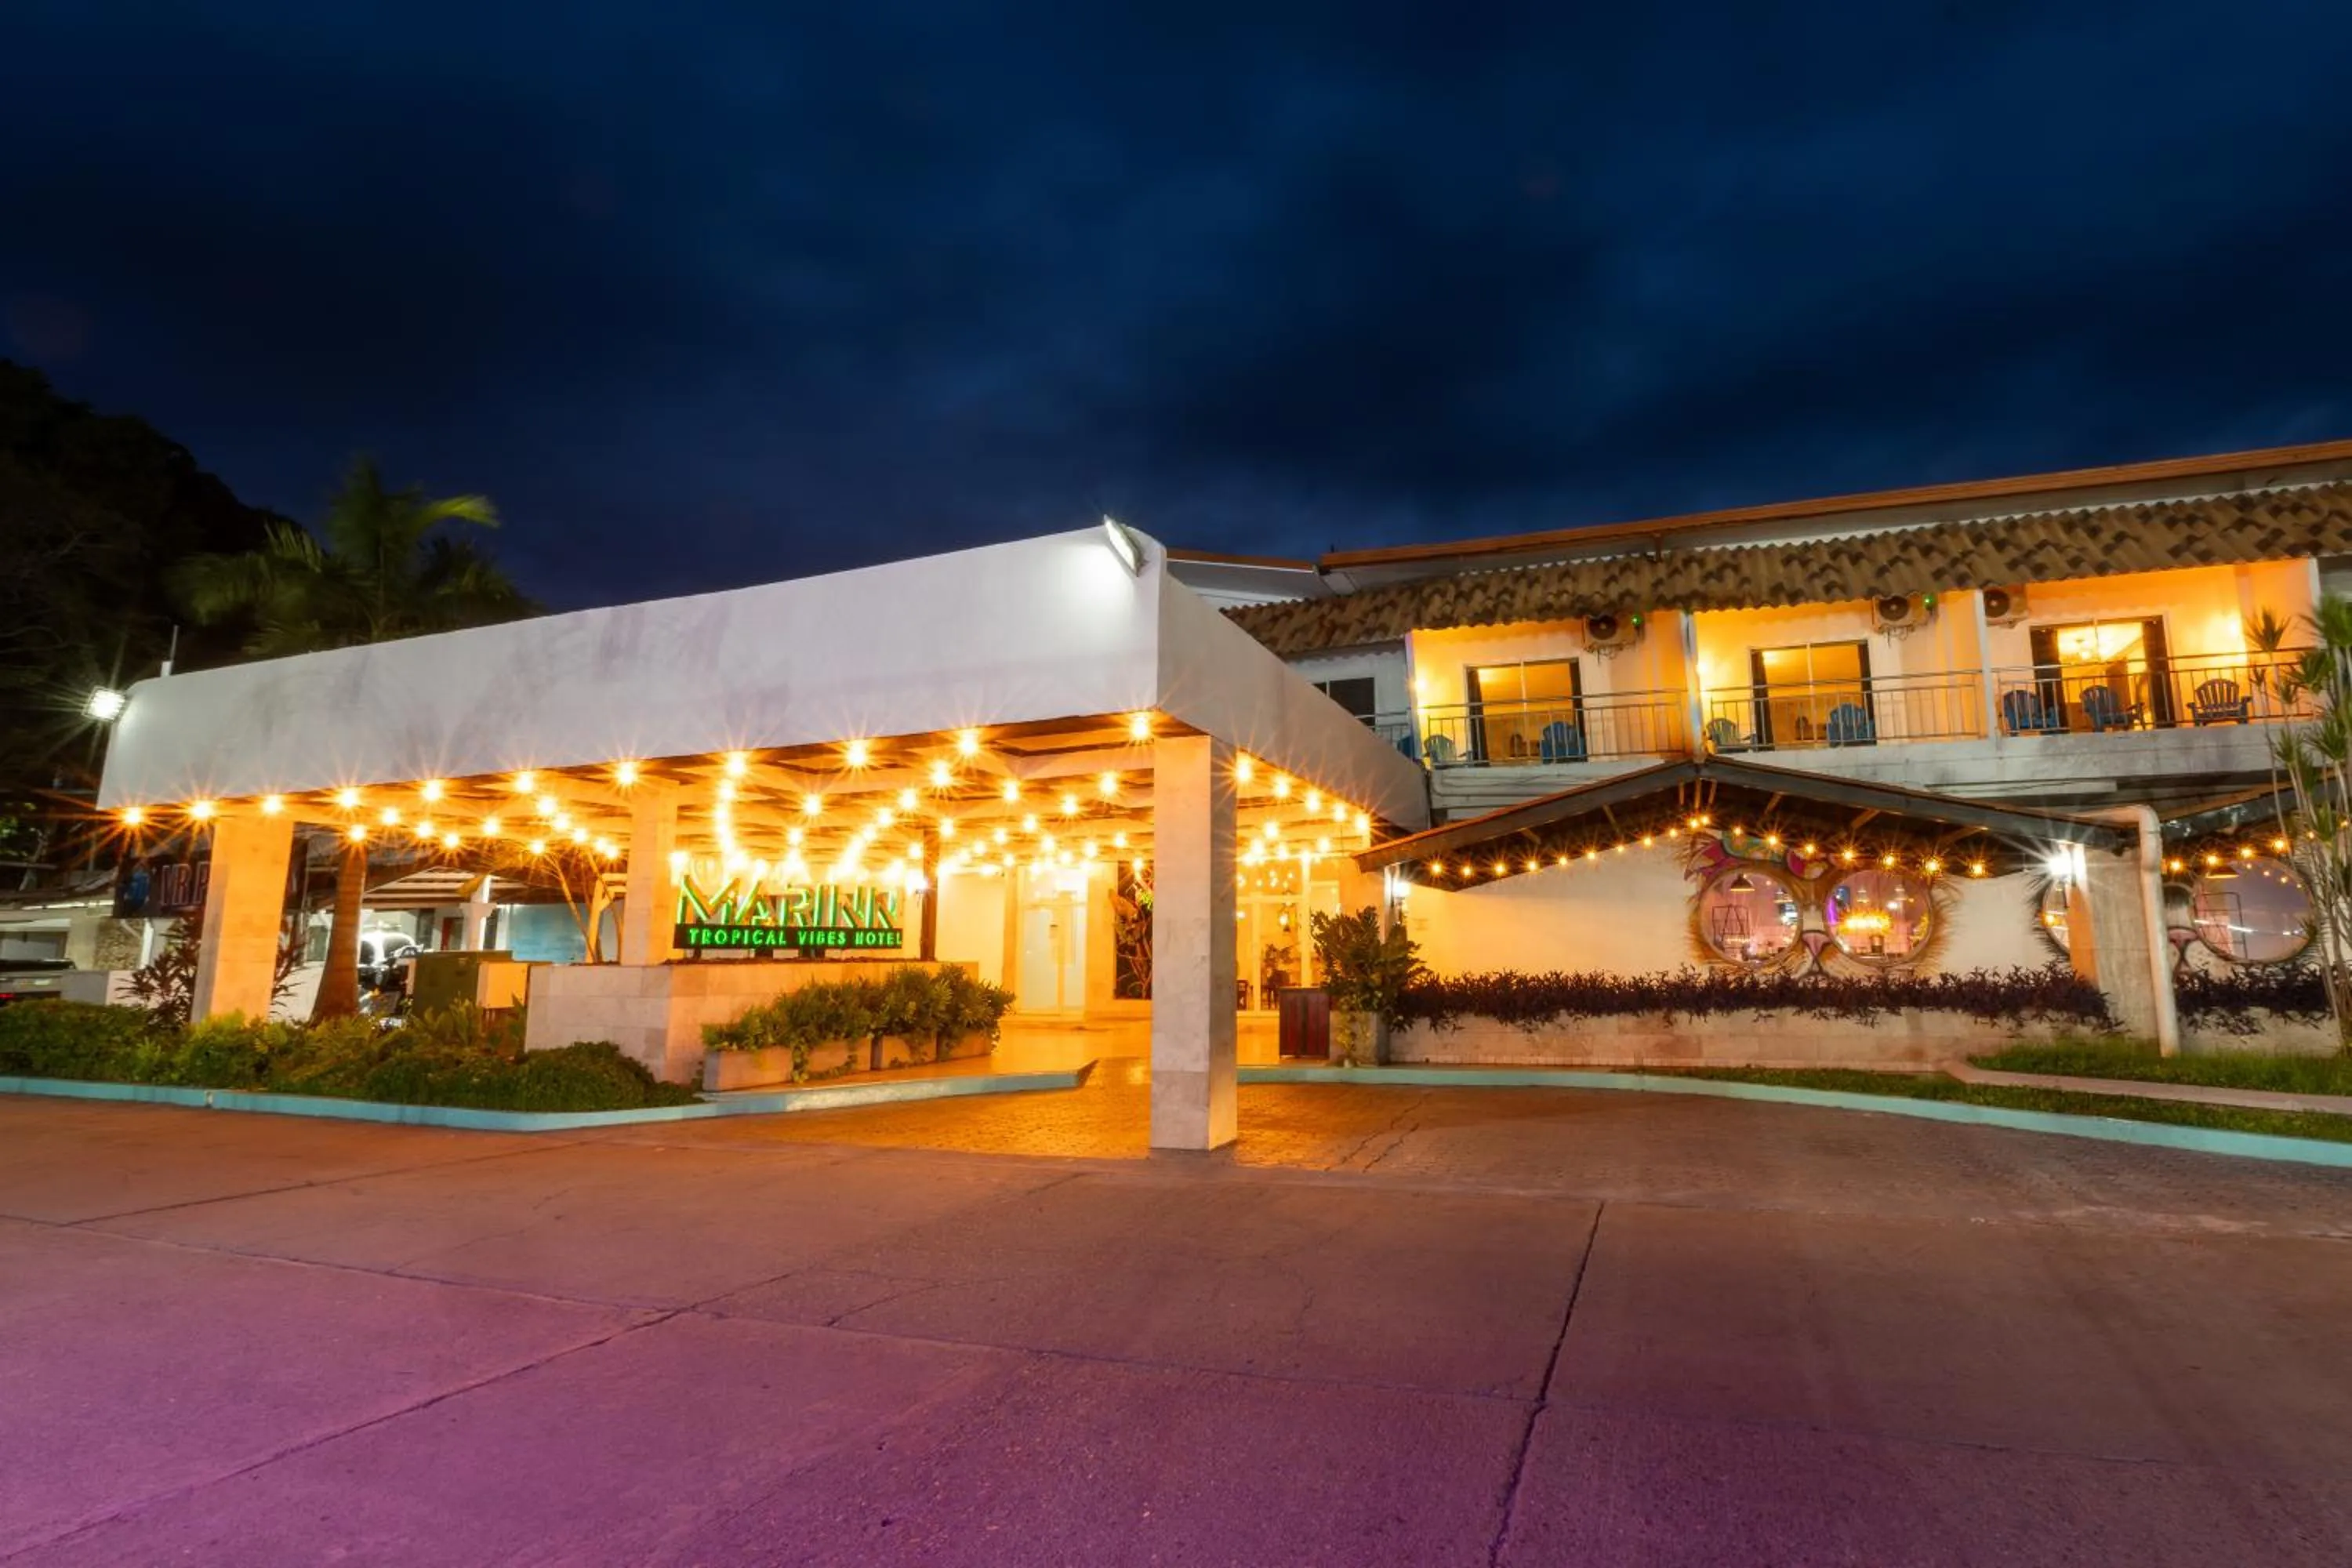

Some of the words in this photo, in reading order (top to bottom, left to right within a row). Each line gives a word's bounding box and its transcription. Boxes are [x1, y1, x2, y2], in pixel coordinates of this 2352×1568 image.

[677, 874, 898, 928] MARINN
[688, 928, 786, 945] TROPICAL
[798, 931, 846, 946] VIBES
[855, 931, 902, 946] HOTEL
